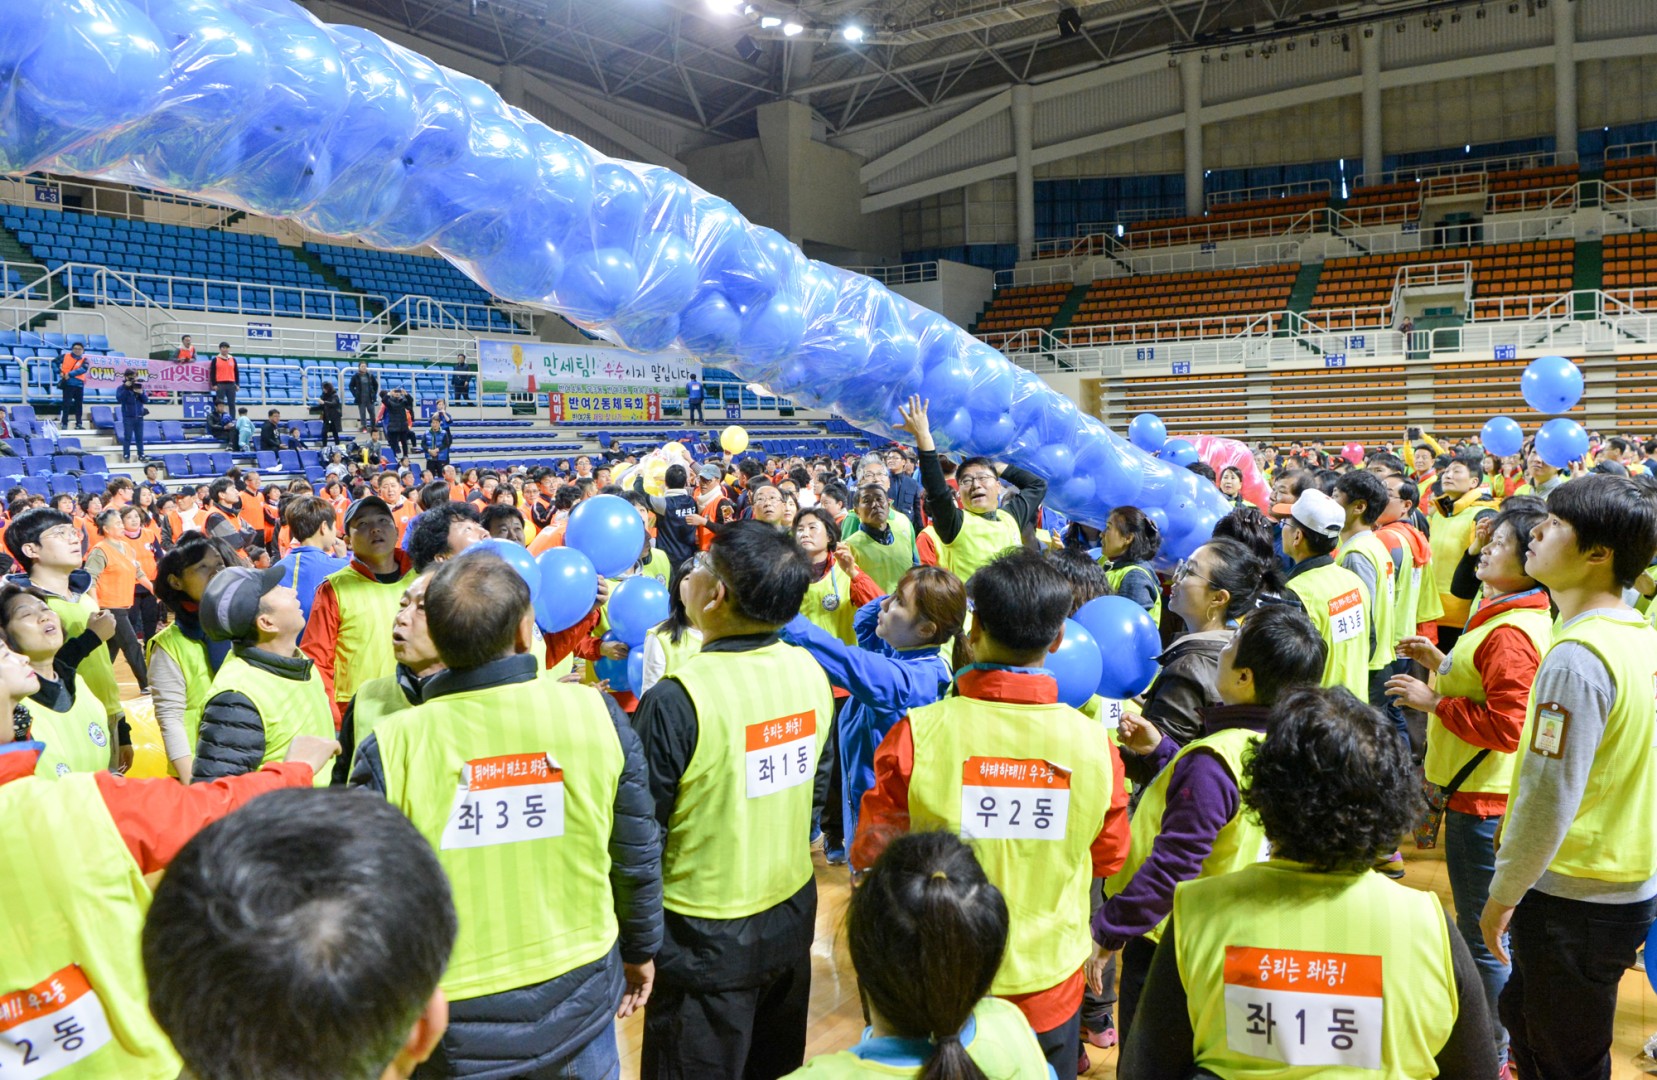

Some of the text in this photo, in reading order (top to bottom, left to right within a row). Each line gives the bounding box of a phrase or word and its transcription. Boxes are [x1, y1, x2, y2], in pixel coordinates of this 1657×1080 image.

[39, 193, 57, 203] 4-3
[251, 330, 268, 338] 3-4
[340, 340, 356, 351] 2-4
[1496, 349, 1514, 359] 1-10
[543, 352, 690, 383] 만세팀! 우승이지 말입니다
[1174, 366, 1188, 374] 1-8
[1328, 358, 1343, 367] 1-9
[159, 364, 209, 383] 파잇팅!
[568, 396, 644, 411] 반여2동체육회
[188, 405, 211, 418] 1-3
[1110, 701, 1121, 720] 좌
[763, 722, 784, 743] 승리는
[979, 761, 1055, 784] 하태하태!! 우2동
[1257, 953, 1347, 987] 승리는 좌1동!
[28, 978, 67, 1011] 우2동
